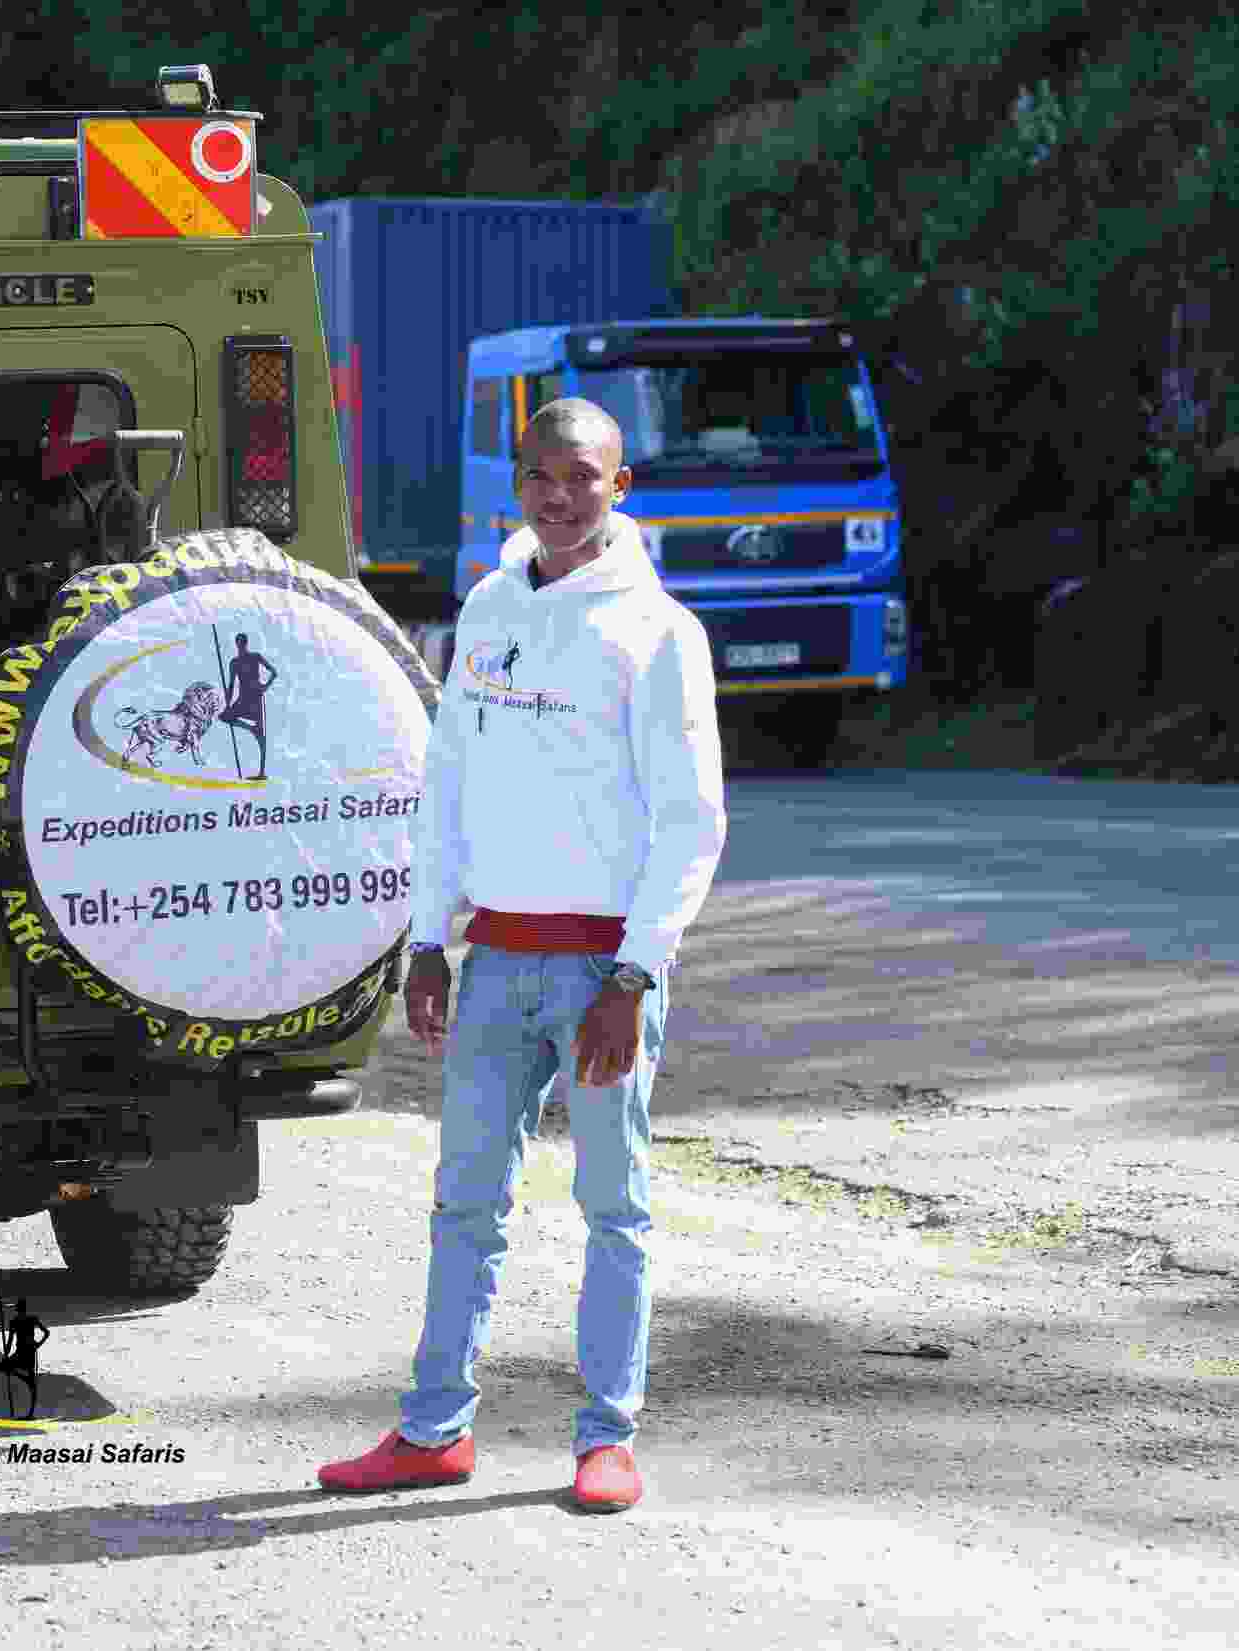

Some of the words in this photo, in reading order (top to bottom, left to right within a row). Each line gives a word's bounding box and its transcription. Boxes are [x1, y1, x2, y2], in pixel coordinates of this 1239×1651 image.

[41, 807, 218, 846] Expeditions
[228, 797, 328, 829] Maasai
[338, 791, 421, 821] Safari
[62, 882, 211, 927] Tel:+254
[223, 876, 283, 914] 783
[290, 871, 352, 909] 999
